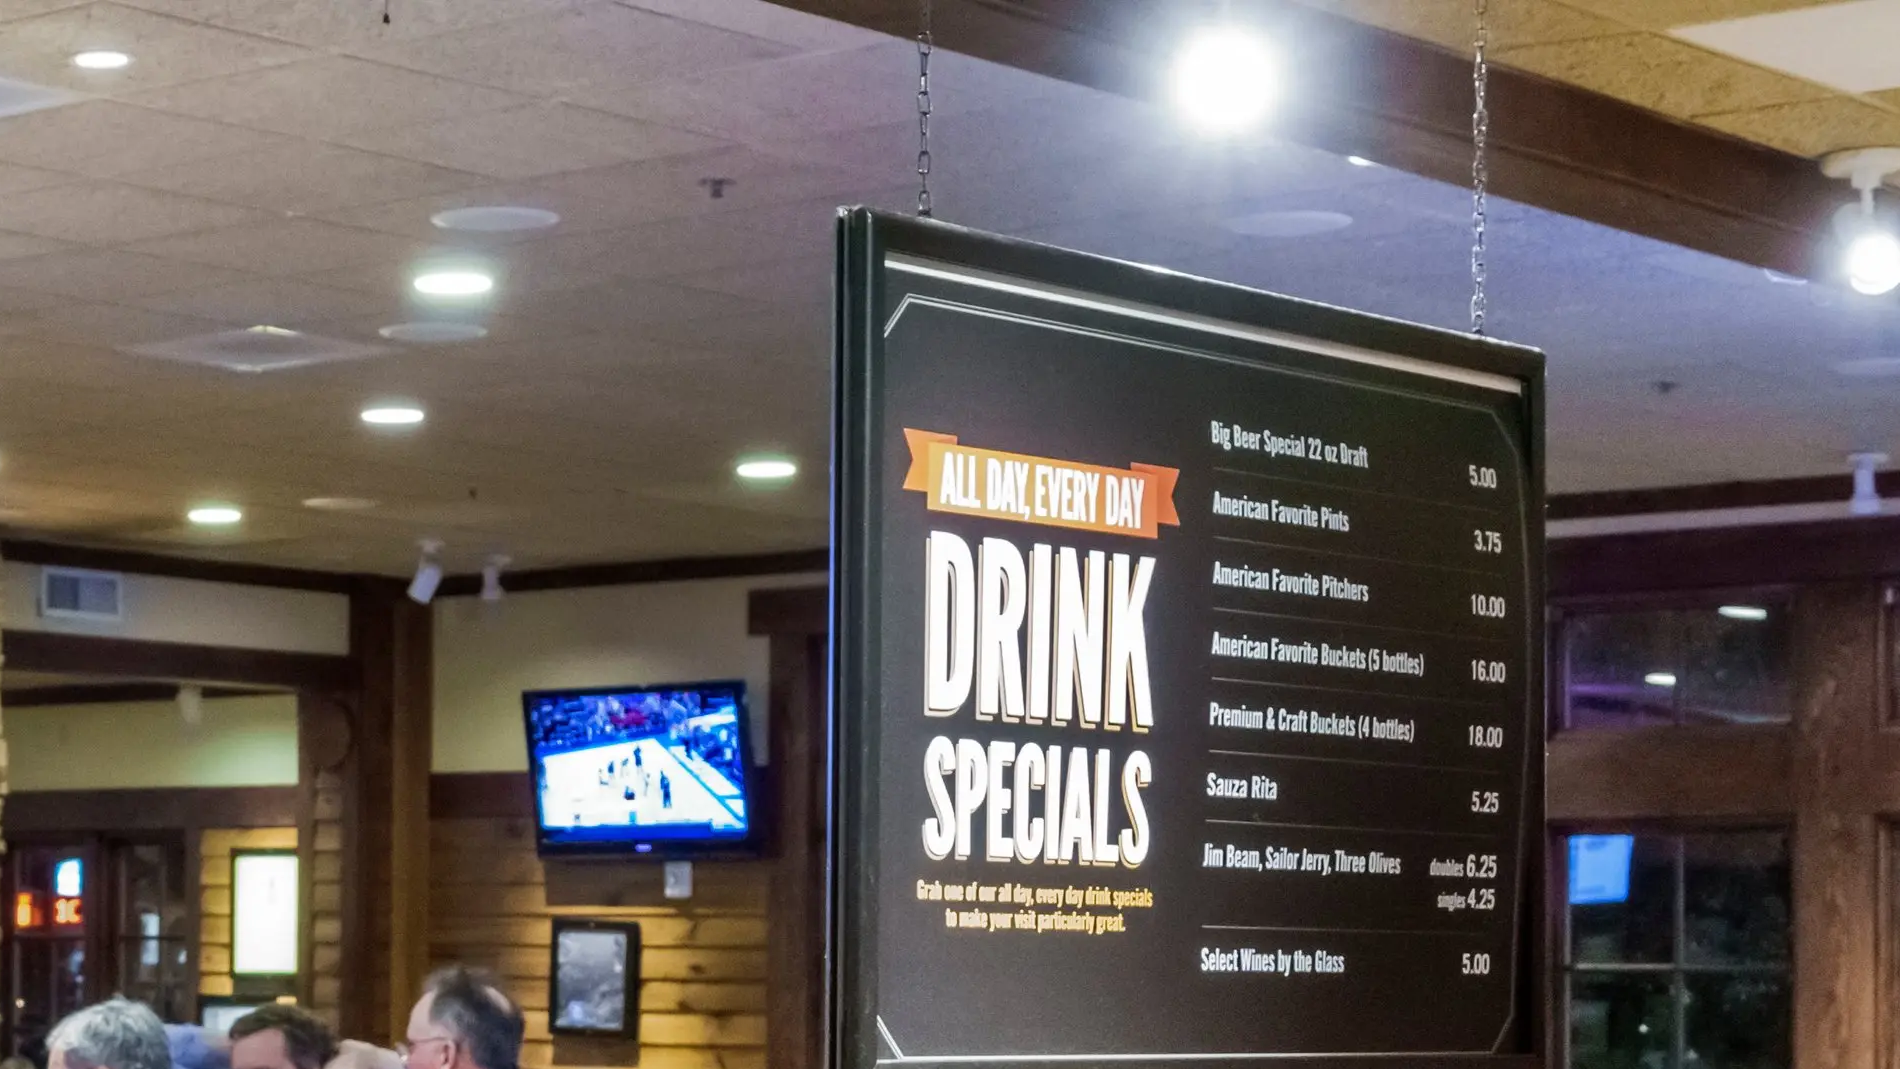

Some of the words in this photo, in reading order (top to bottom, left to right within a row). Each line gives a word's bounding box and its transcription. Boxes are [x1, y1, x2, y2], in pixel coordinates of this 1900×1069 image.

[1211, 420, 1231, 450] Big
[1233, 424, 1261, 450] Beer
[1263, 429, 1306, 457] Special
[1308, 437, 1322, 460] 22
[1324, 443, 1338, 463] oz
[1340, 442, 1369, 468] Draft
[940, 452, 981, 508] ALL
[986, 458, 1030, 520] DAY,
[1035, 465, 1100, 524] EVERY
[1105, 474, 1145, 528] DAY
[1469, 464, 1497, 489] 5.00
[1213, 491, 1269, 521] American
[1271, 500, 1318, 528] Favorite
[1321, 506, 1349, 532] Pints
[1474, 530, 1502, 554] 3.75
[1213, 561, 1269, 590] American
[1272, 568, 1320, 596] Favorite
[1322, 574, 1369, 602] Pitchers
[1471, 594, 1506, 618] 10.00
[924, 530, 1157, 733] DRINK
[1211, 631, 1268, 660] American
[1271, 637, 1318, 666] Favorite
[1321, 643, 1366, 670] Buckets
[1368, 648, 1380, 673] (5
[1382, 650, 1425, 677] bottles)
[1471, 660, 1506, 683] 16.00
[1209, 701, 1264, 730] Premium
[1266, 706, 1275, 731] &
[1278, 708, 1308, 733] Craft
[1310, 711, 1356, 737] Buckets
[1358, 715, 1370, 740] (4
[1372, 716, 1415, 744] bottles)
[1468, 725, 1503, 748] 18.00
[1206, 772, 1248, 799] Sauza
[1251, 775, 1278, 800] Rita
[923, 735, 1153, 869] SPECIALS
[1471, 790, 1499, 813] 5.25
[1202, 843, 1224, 868] Jim
[1226, 844, 1263, 872] Beam,
[1265, 846, 1300, 871] Sailor
[1301, 848, 1331, 876] Jerry,
[1334, 850, 1365, 873] Three
[1368, 851, 1401, 875] Olives
[1429, 858, 1464, 877] doubles
[1466, 854, 1497, 879] 6.25
[917, 879, 942, 900] Grab
[944, 884, 964, 901] one
[966, 881, 977, 901] of
[978, 886, 997, 902] our
[999, 883, 1012, 903] all
[1014, 884, 1034, 907] day,
[1036, 887, 1064, 908] every
[1066, 886, 1084, 908] day
[1086, 886, 1111, 906] drink
[1113, 888, 1153, 909] specials
[1467, 888, 1495, 910] 4.25
[945, 908, 957, 928] to
[959, 908, 987, 929] make
[990, 912, 1013, 932] your
[1014, 910, 1036, 930] visit
[1037, 912, 1095, 934] particularly
[1096, 913, 1126, 934] great.
[1201, 947, 1239, 973] Select
[1240, 948, 1275, 973] Wines
[1277, 949, 1291, 977] by
[1293, 949, 1312, 973] the
[1315, 950, 1345, 973] Glass
[1462, 953, 1491, 975] 5.00
